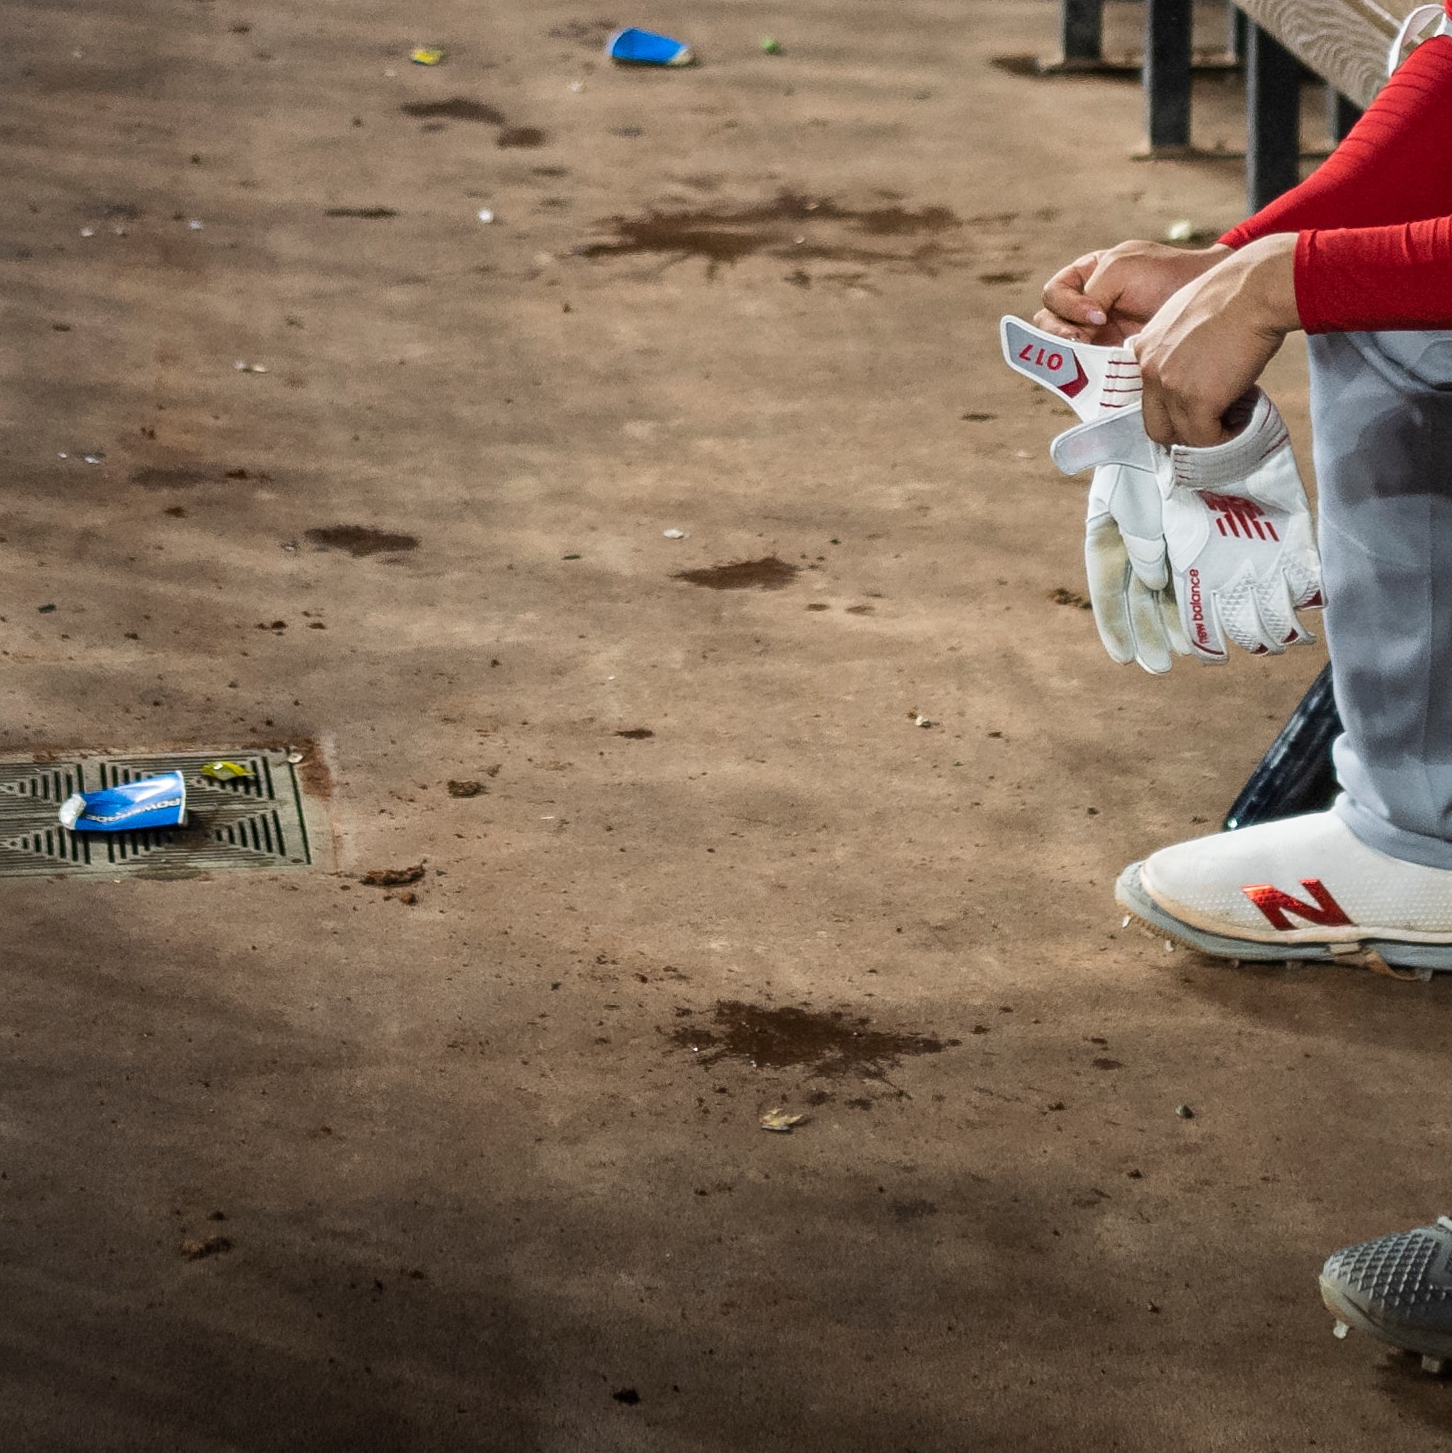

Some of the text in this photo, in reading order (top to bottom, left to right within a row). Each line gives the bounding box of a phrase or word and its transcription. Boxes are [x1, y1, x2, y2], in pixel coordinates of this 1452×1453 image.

[1018, 343, 1063, 371] 017
[1190, 569, 1208, 643] new balance
[1241, 877, 1357, 932] N
